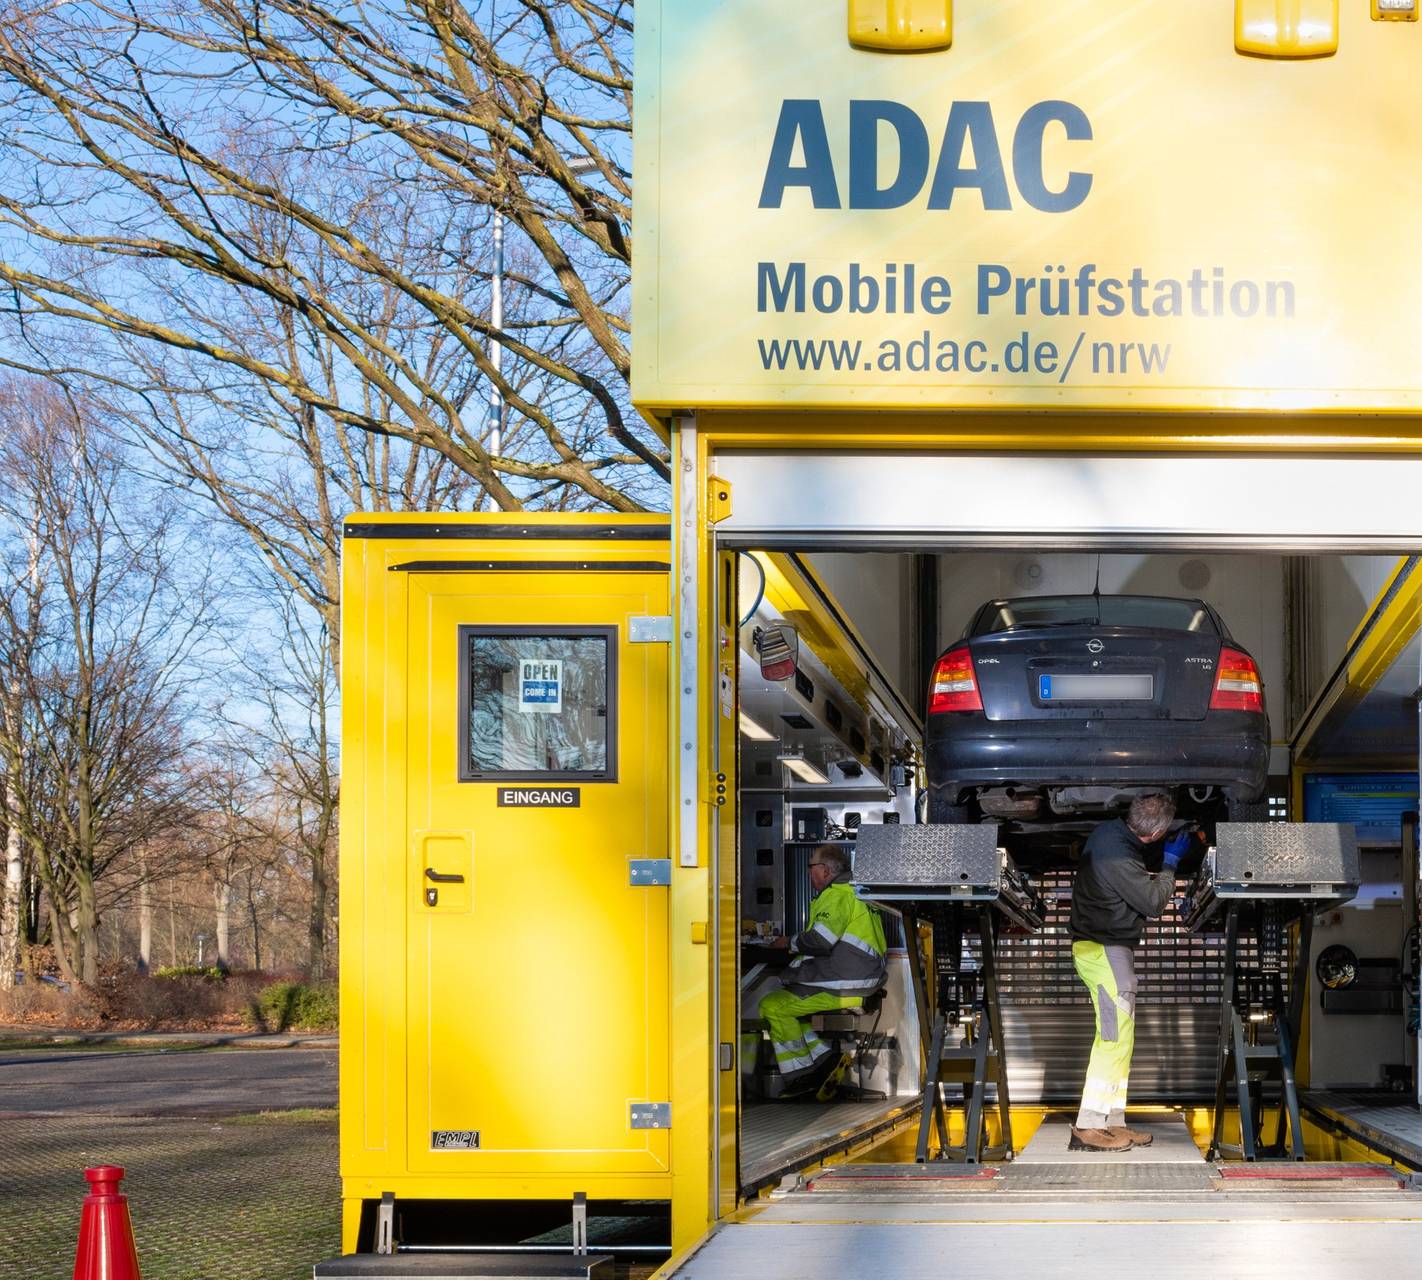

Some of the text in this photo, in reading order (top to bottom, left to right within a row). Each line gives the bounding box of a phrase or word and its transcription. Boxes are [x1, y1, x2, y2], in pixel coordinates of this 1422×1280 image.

[759, 99, 1094, 213] ADAC
[757, 262, 1297, 319] Mobile Prüfstation
[757, 331, 1173, 384] www.adac.de/nrw
[523, 663, 558, 680] OPEN
[524, 688, 557, 697] COME IN
[503, 791, 573, 804] EINGANG
[434, 1132, 478, 1147] EMPL
